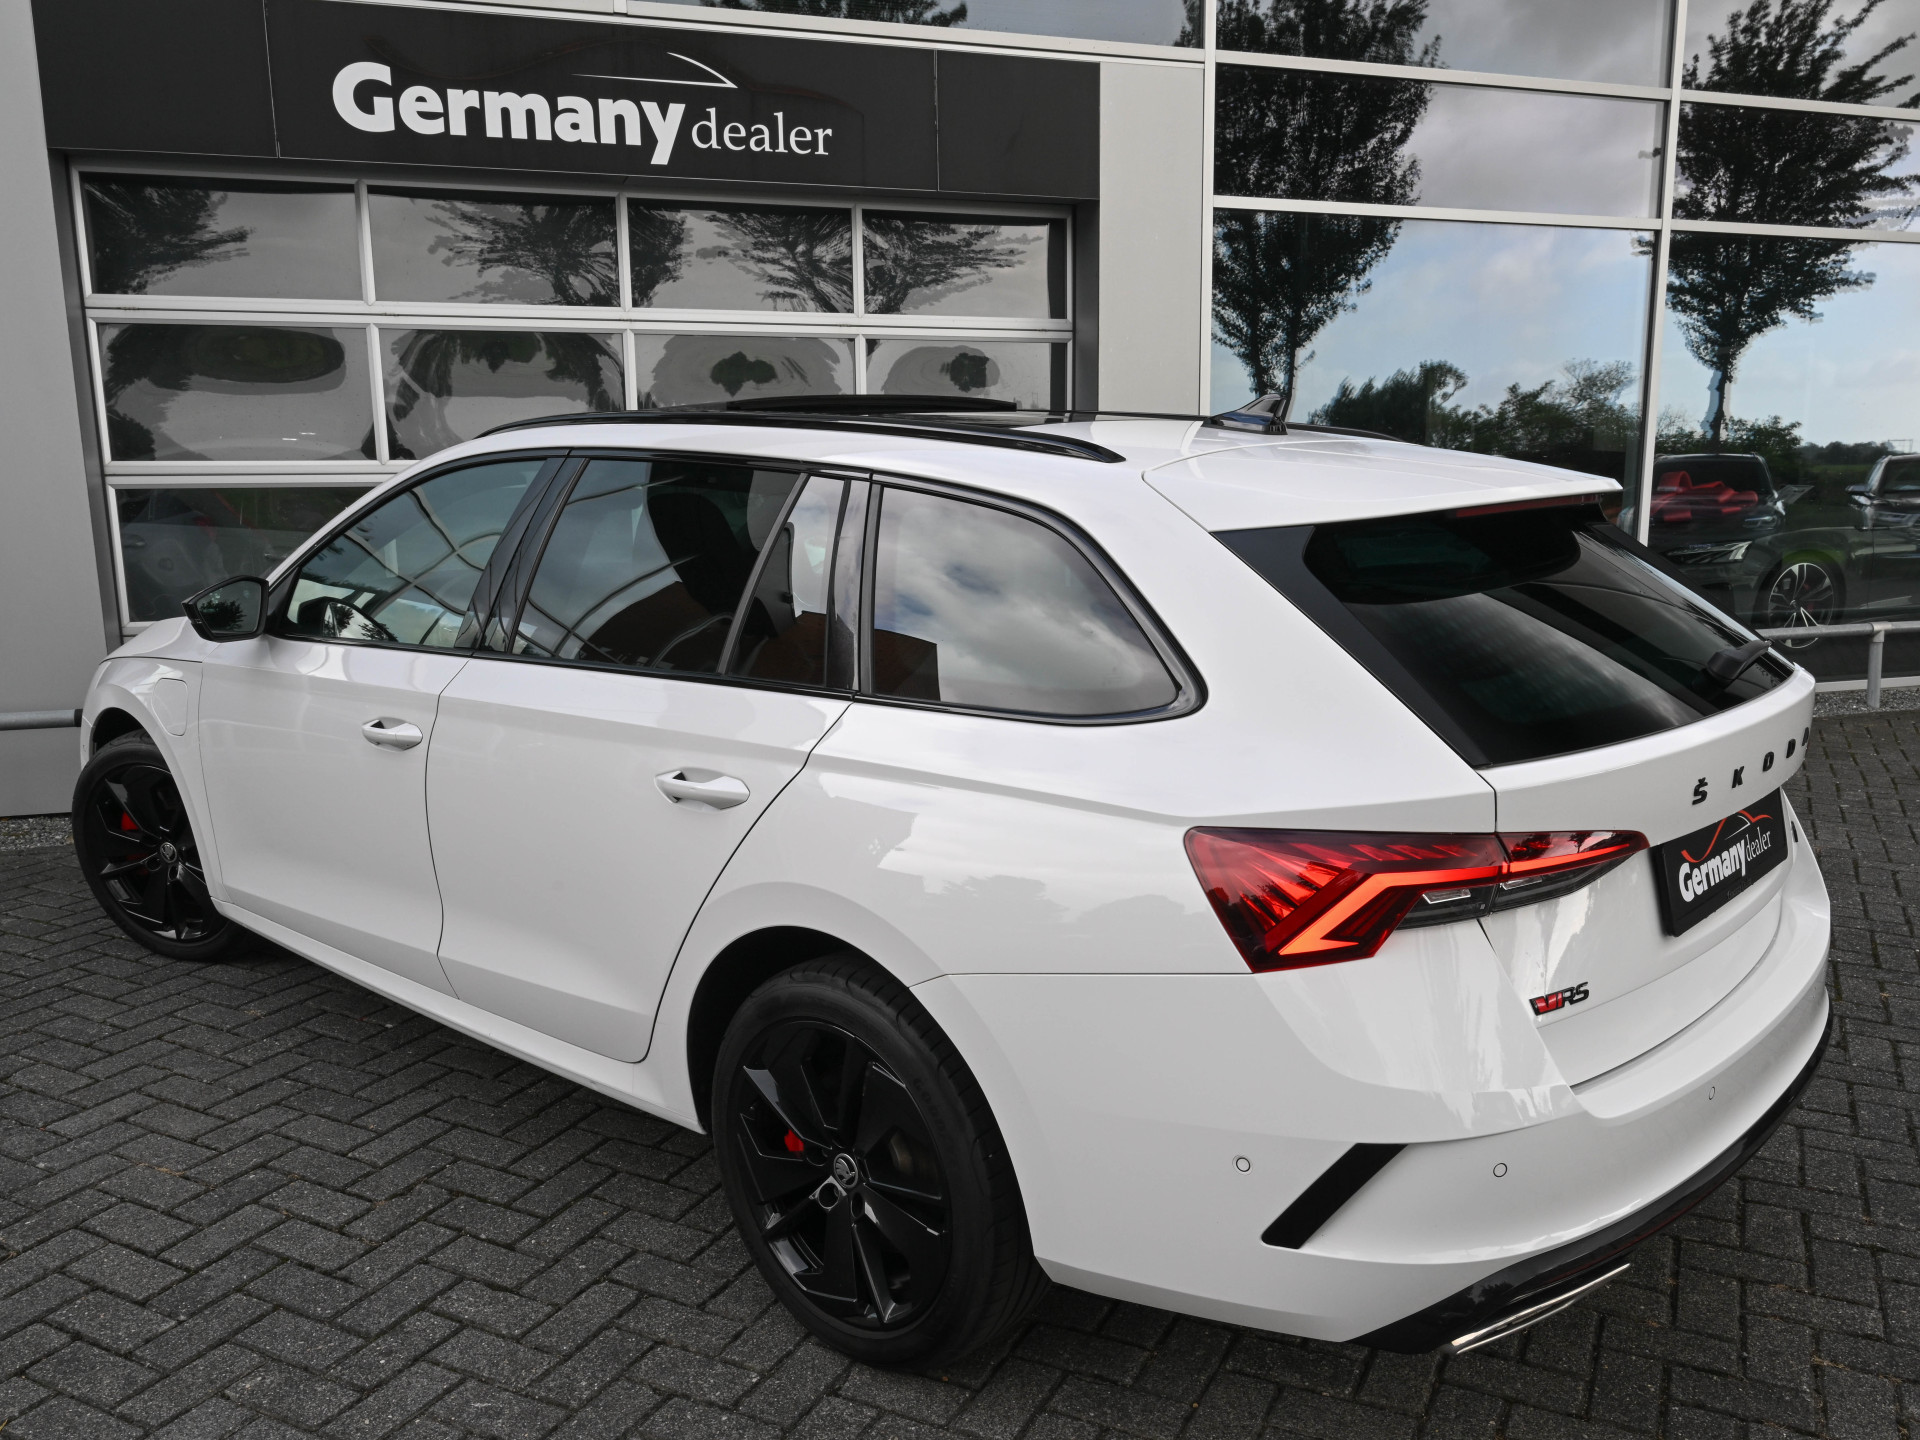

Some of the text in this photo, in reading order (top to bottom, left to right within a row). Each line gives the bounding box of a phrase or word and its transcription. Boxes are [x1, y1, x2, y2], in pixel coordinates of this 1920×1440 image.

[332, 61, 833, 166] Germany dealer
[1678, 839, 1747, 903] Germany
[1745, 826, 1772, 862] dealer
